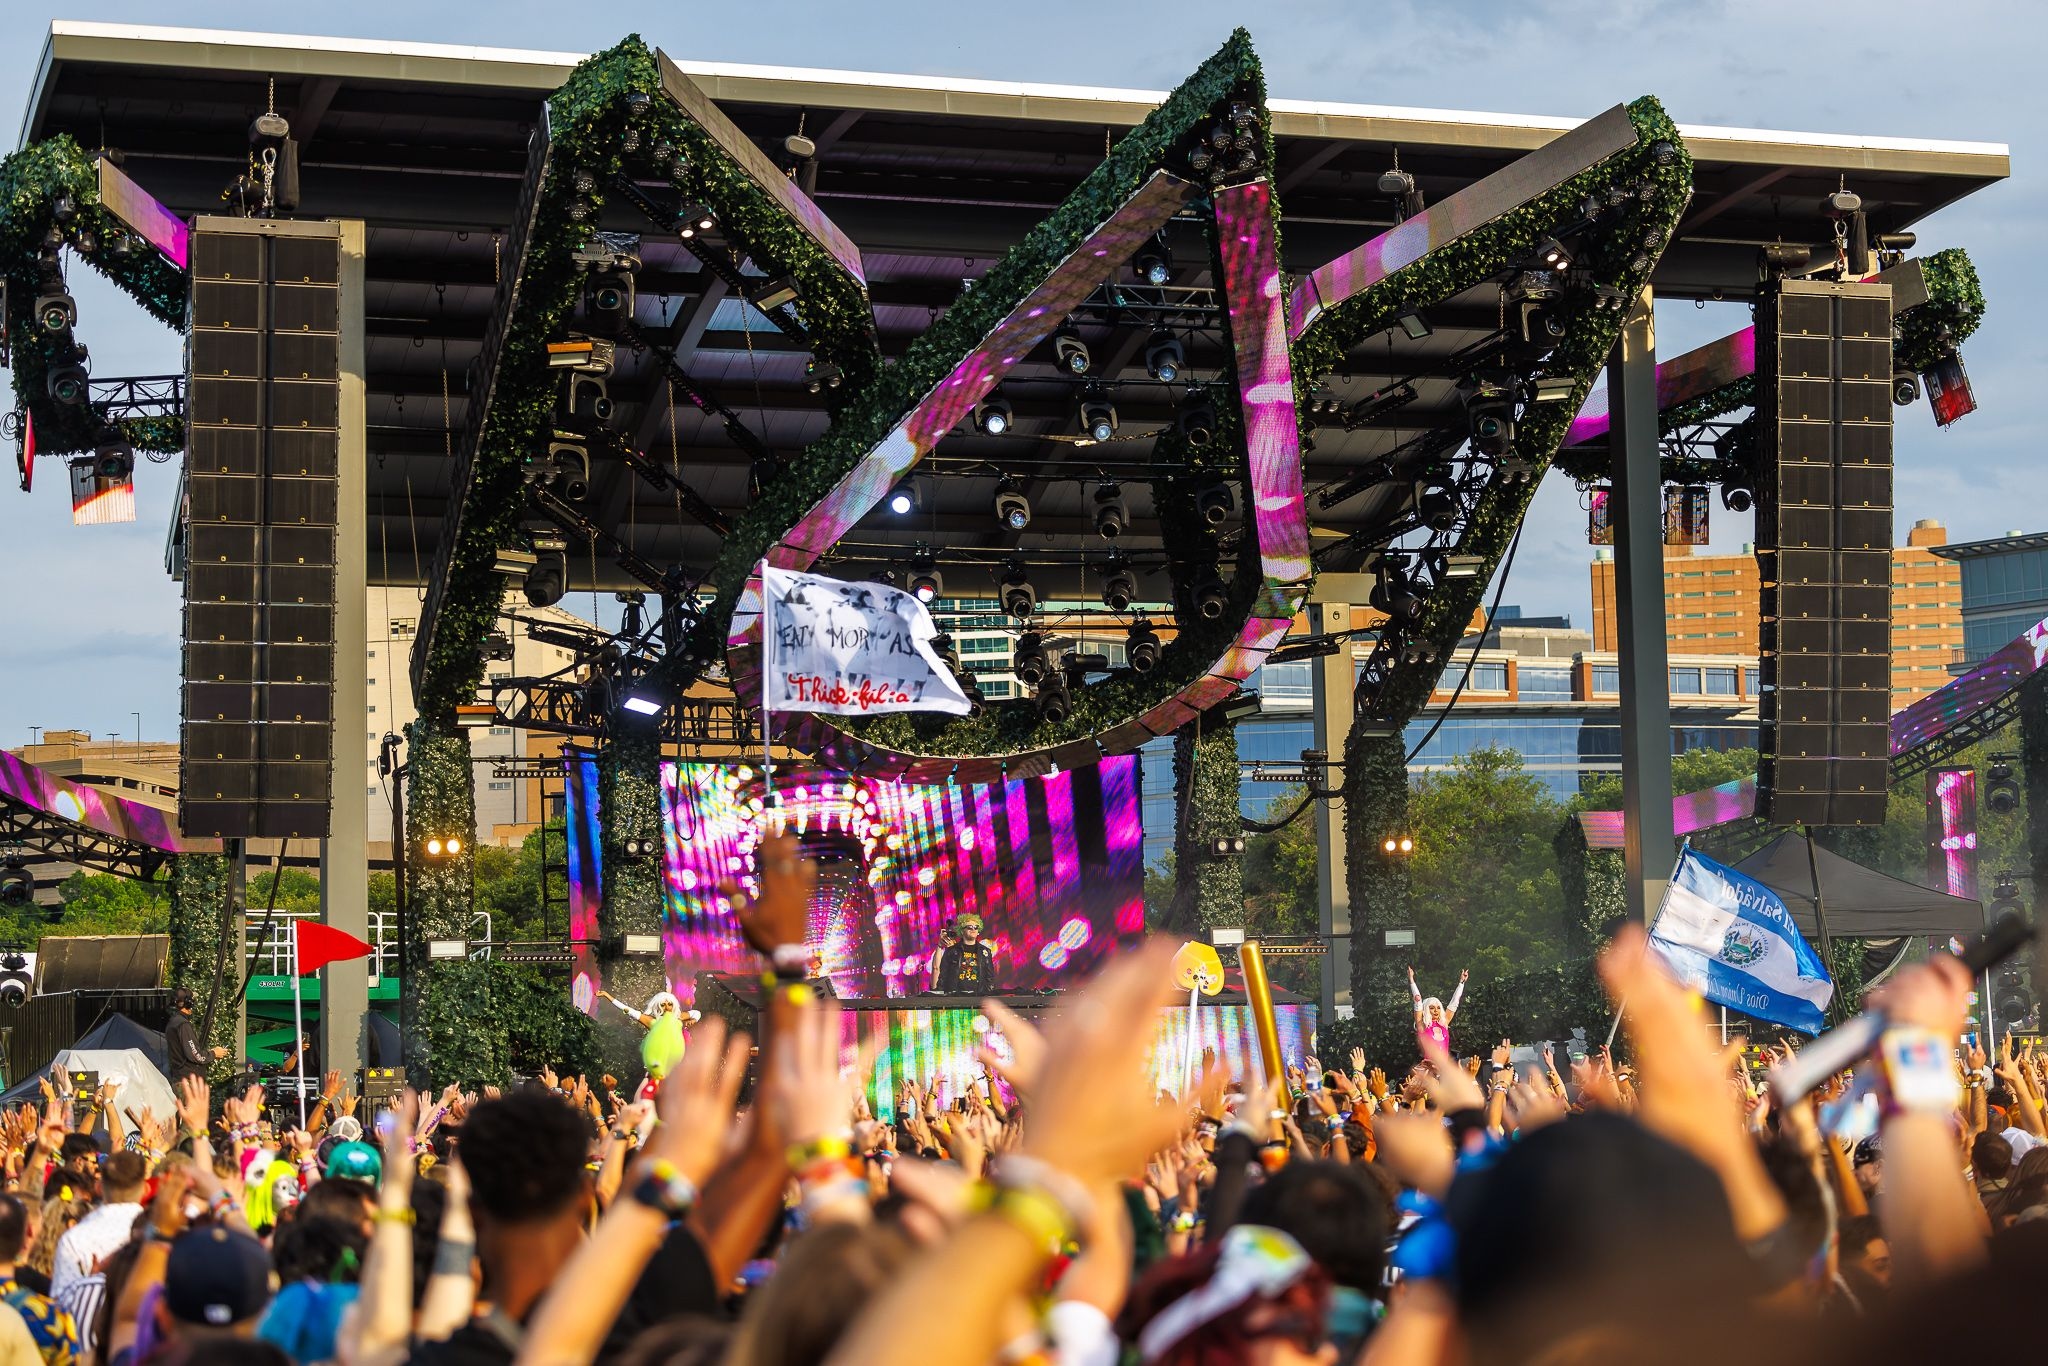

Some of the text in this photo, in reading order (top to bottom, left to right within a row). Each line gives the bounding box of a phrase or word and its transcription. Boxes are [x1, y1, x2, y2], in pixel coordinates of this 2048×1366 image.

[782, 624, 923, 659] EAT MOR AS
